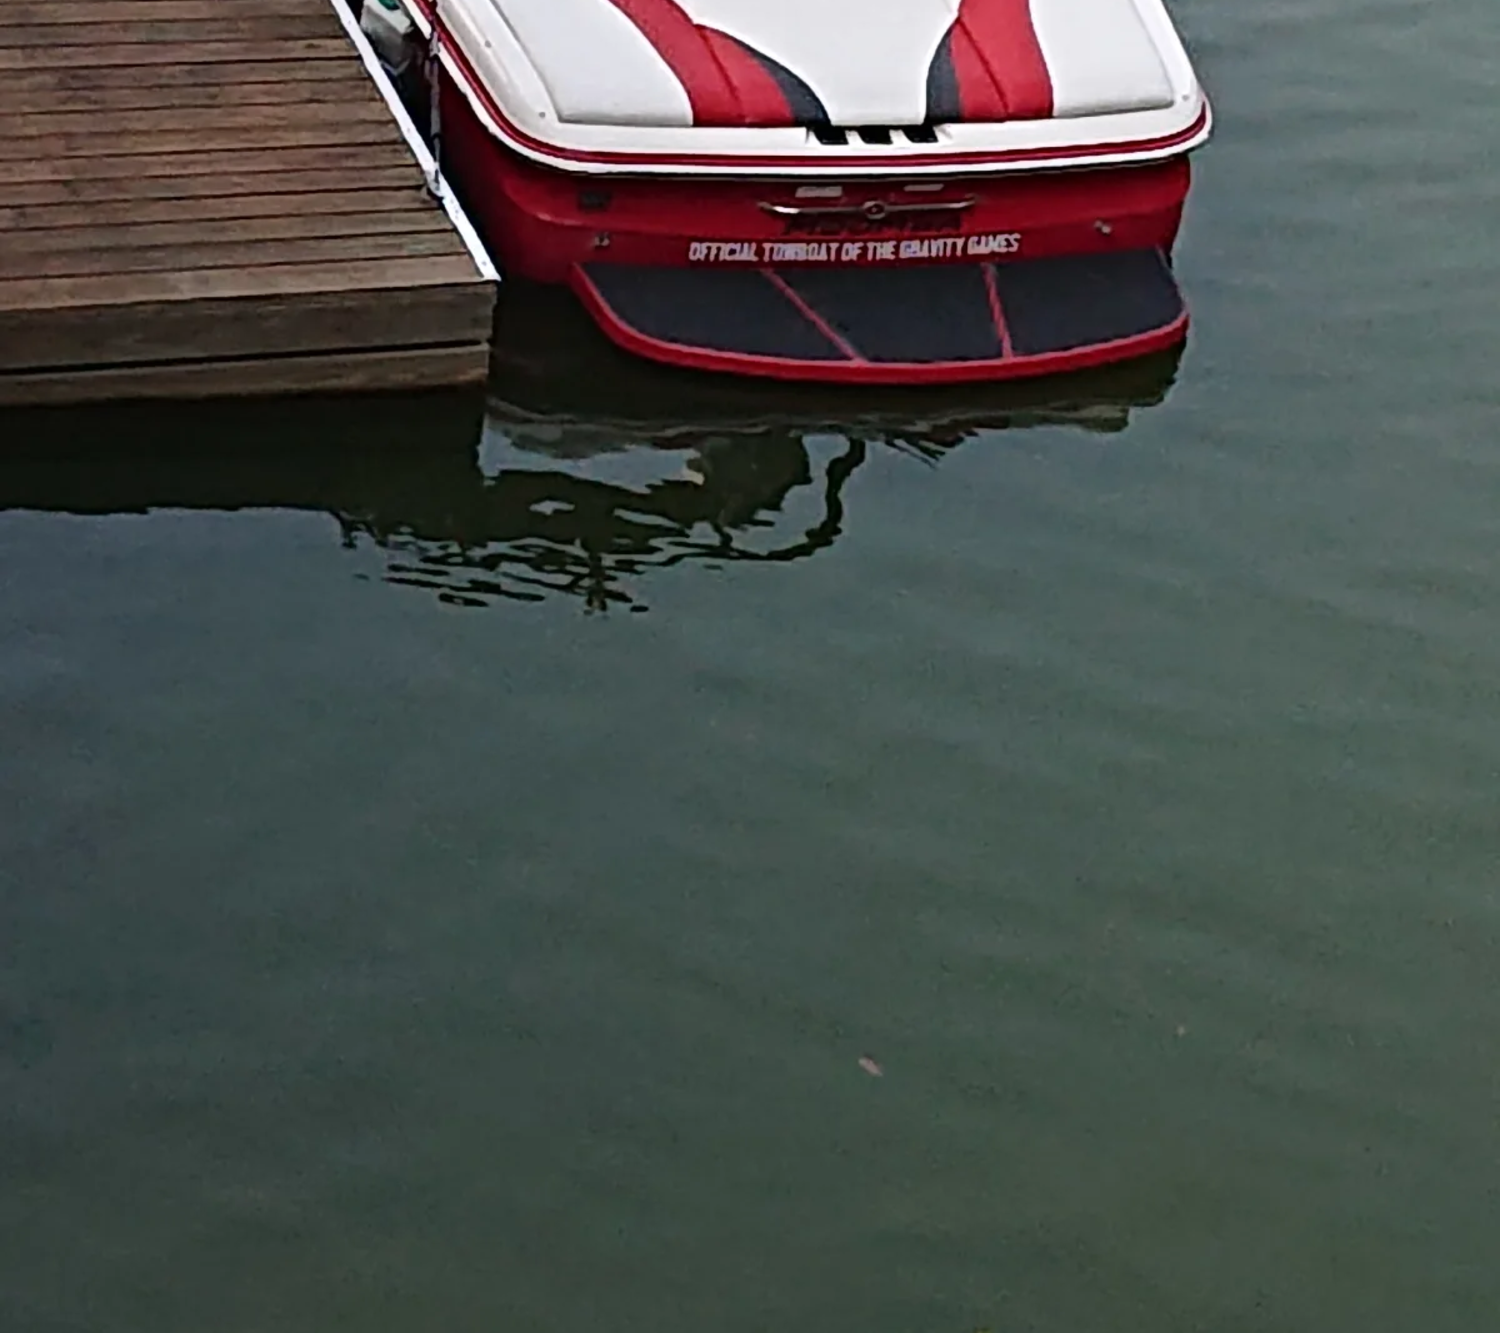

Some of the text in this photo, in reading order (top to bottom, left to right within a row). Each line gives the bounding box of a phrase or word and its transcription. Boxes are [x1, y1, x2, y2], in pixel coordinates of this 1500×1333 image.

[689, 241, 759, 262] OFFICIAL
[841, 241, 865, 261] OF
[866, 240, 897, 261] THE
[967, 232, 1021, 255] GAMES
